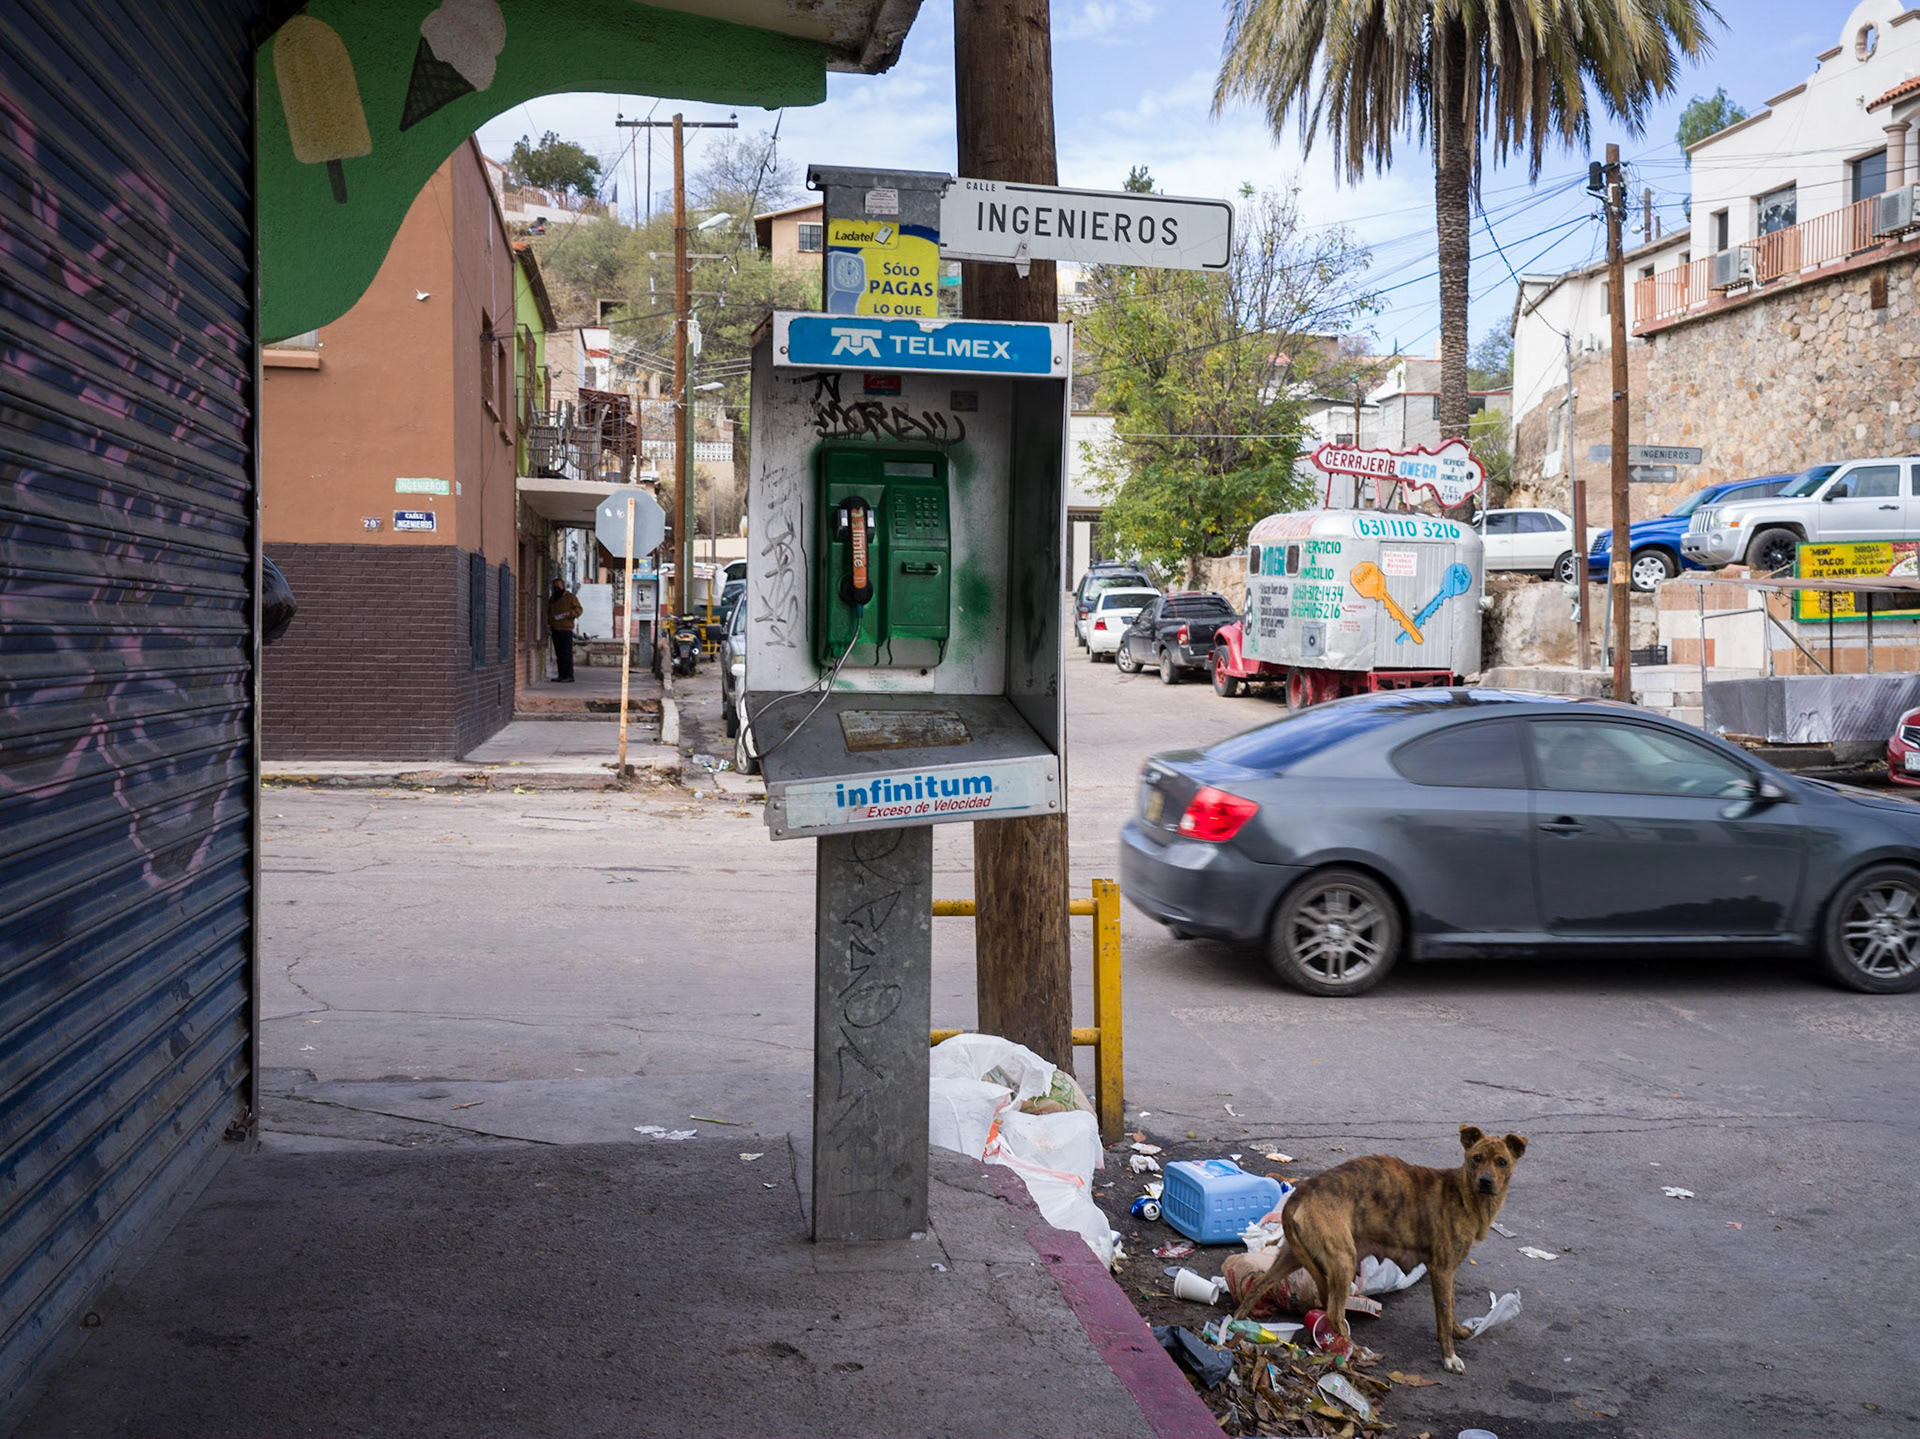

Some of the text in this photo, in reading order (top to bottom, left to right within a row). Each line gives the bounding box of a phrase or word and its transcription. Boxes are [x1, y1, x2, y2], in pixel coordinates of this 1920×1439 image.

[965, 181, 997, 193] CALLE
[977, 201, 1179, 246] INGENIEROS
[834, 230, 874, 242] Ladatel
[883, 261, 920, 277] SÓLO
[869, 279, 934, 297] PAGAS
[873, 303, 890, 315] LO
[889, 334, 1011, 361] TELMEX
[1640, 449, 1690, 460] INGENIEROS
[1325, 451, 1396, 474] CERRAJERIA
[1399, 460, 1438, 480] OMEGA
[398, 480, 447, 491] INGENIEROS
[396, 520, 433, 529] INGENIEROS
[1421, 521, 1461, 539] 3216
[1310, 554, 1317, 566] A
[1817, 558, 1845, 566] TACOS
[1812, 567, 1884, 577] DE CARNE ASADA
[836, 775, 993, 807] infinitum
[867, 796, 992, 819] Exceso de Velocidad
